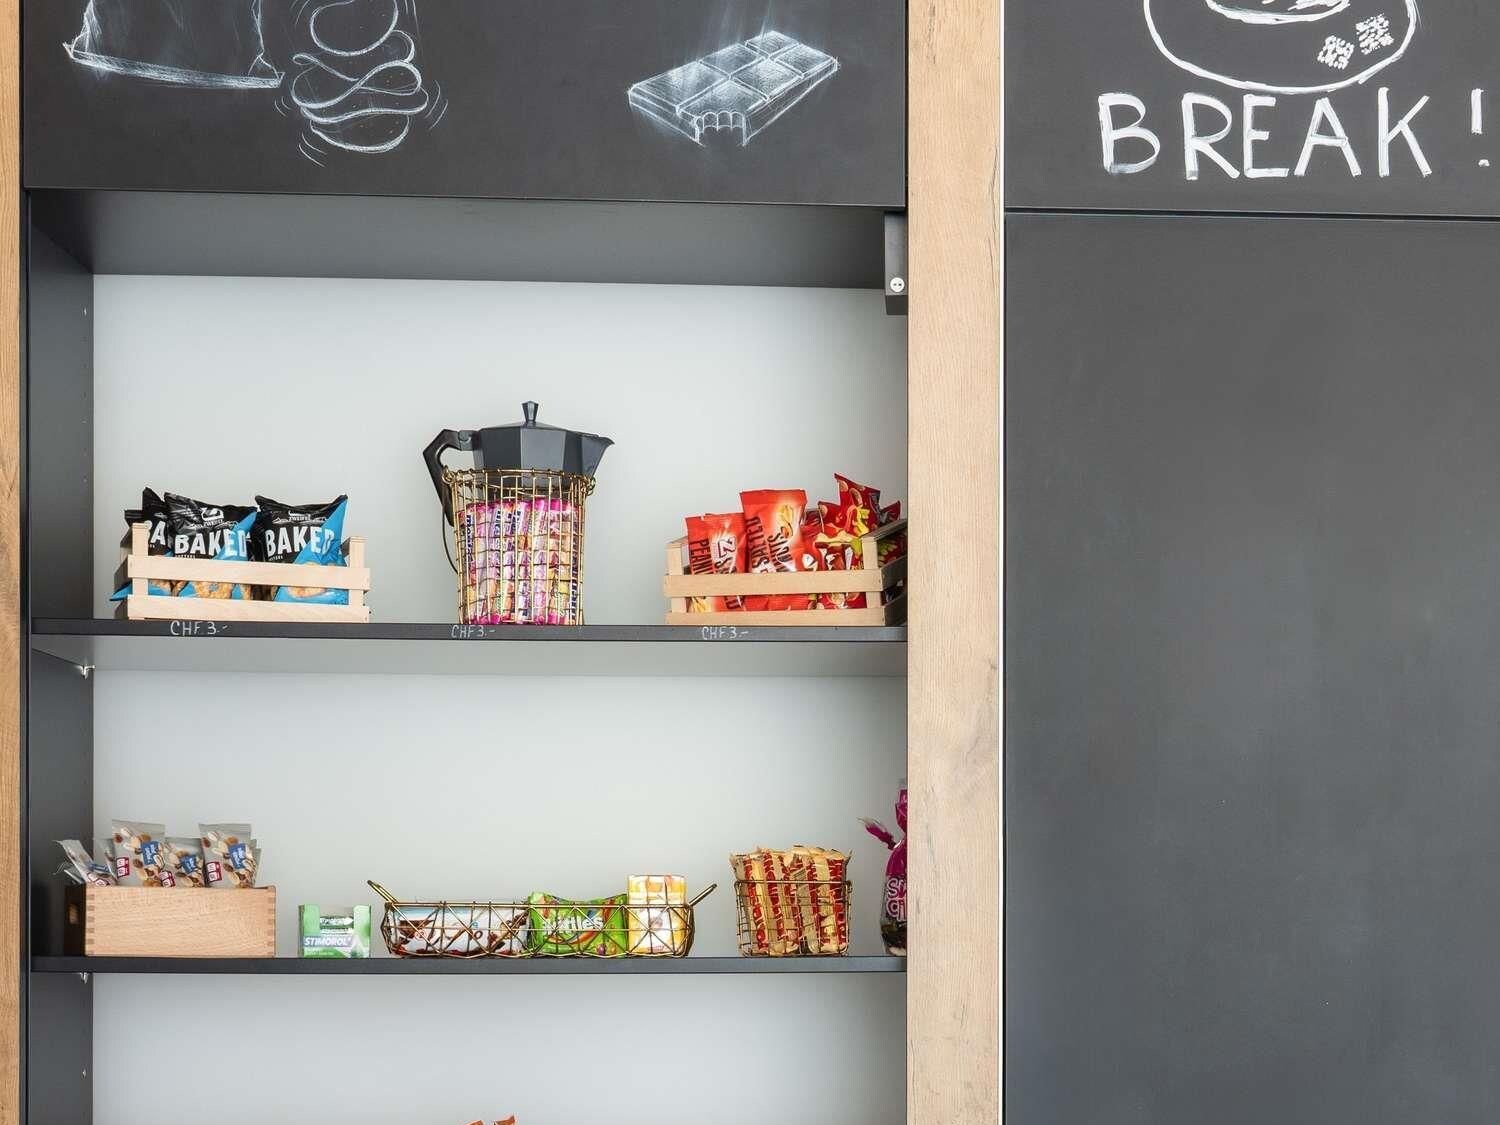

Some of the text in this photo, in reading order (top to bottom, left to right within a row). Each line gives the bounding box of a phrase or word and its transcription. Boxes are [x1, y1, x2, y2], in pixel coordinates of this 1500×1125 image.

[1099, 87, 1432, 180] BREAK
[265, 526, 335, 557] BAKED
[451, 625, 476, 638] CHF
[305, 936, 348, 947] STIMOROL
